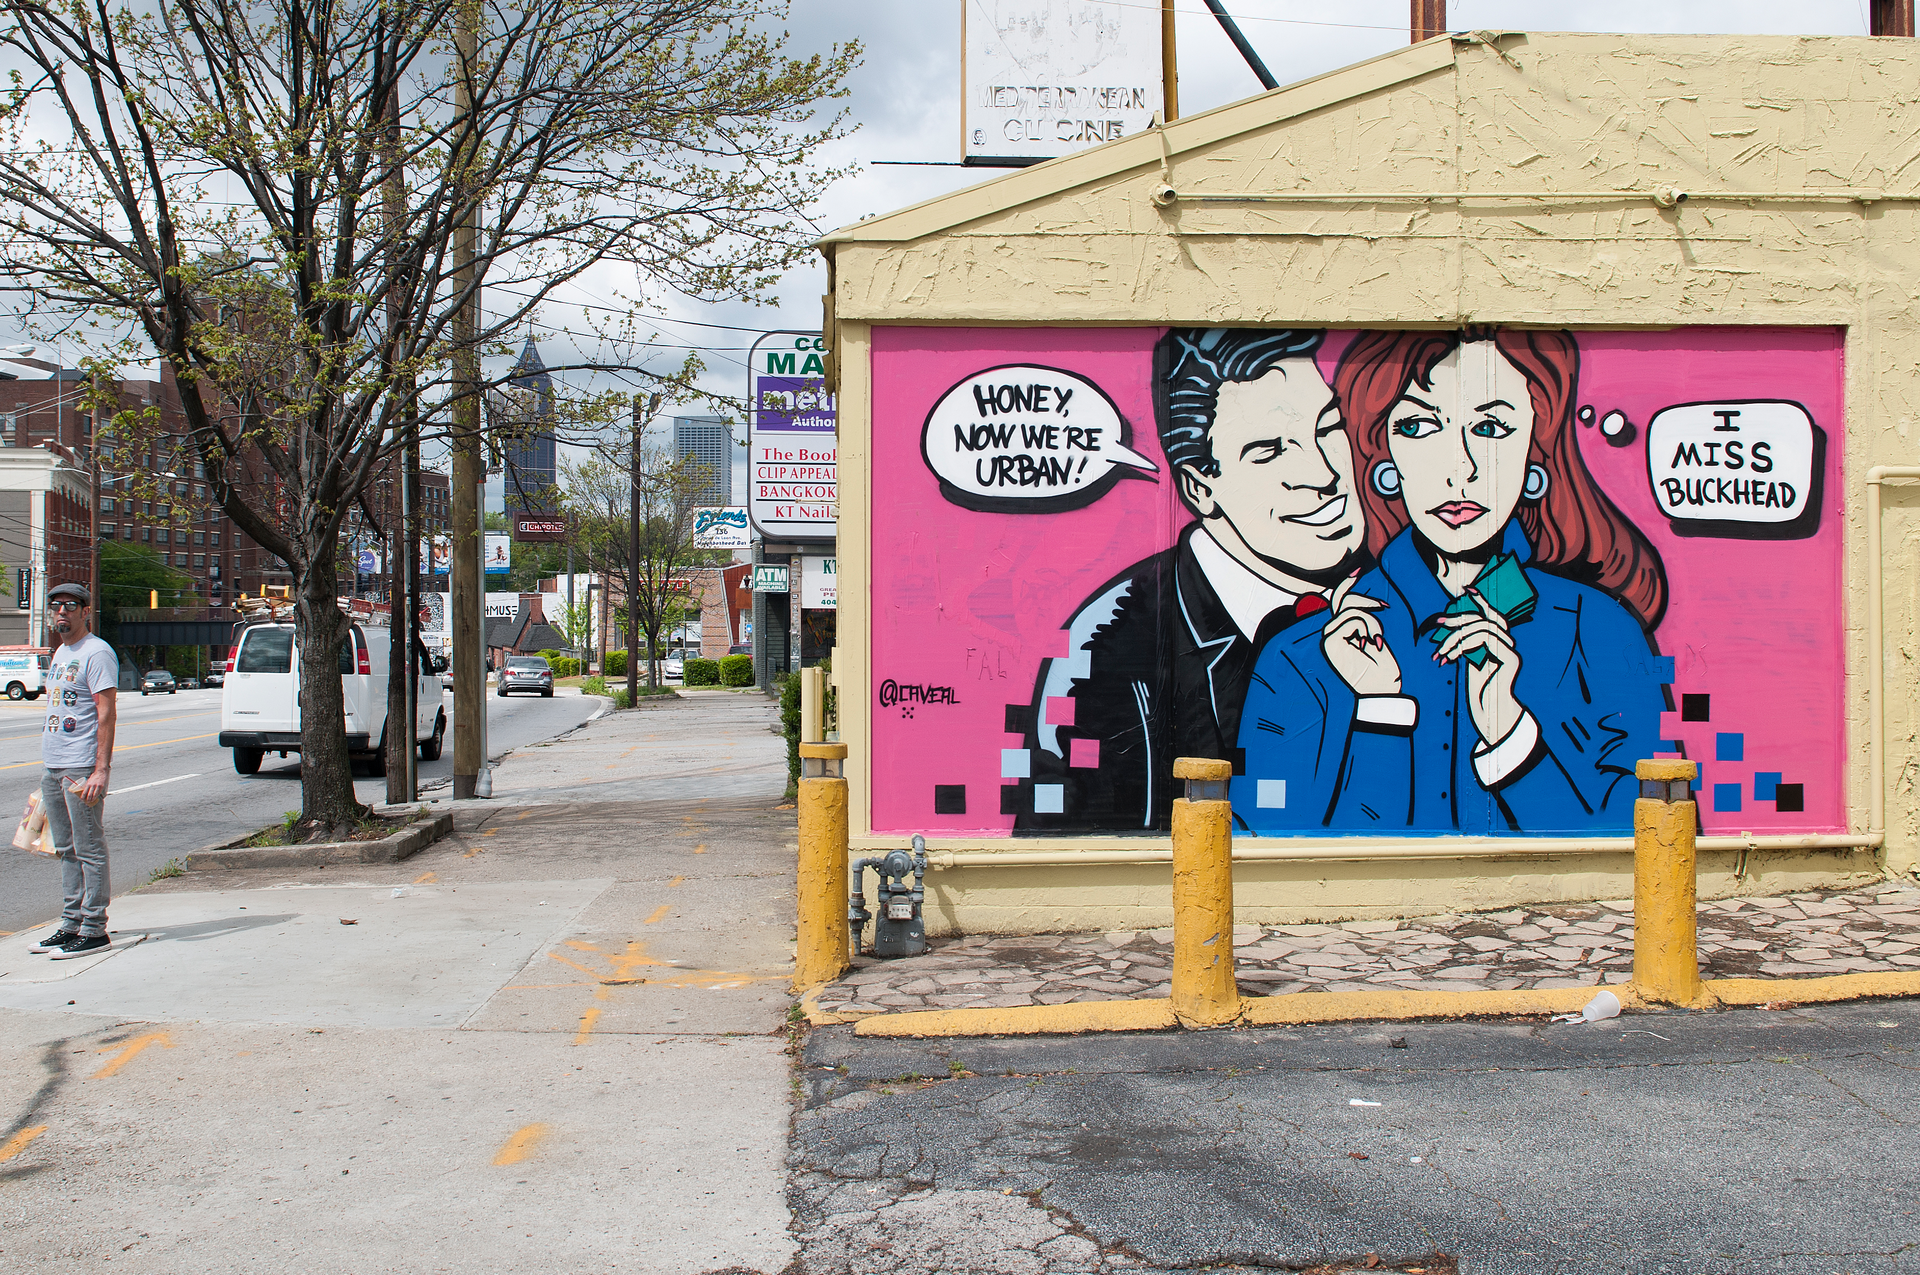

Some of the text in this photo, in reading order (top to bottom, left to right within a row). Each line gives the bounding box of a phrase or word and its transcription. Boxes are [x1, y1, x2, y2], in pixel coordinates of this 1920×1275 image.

[767, 352, 825, 374] MA
[973, 384, 1073, 418] HONEY,
[1713, 410, 1741, 431] I
[954, 423, 1103, 452] NOW WE'RE
[762, 448, 794, 460] The
[1671, 441, 1774, 473] MISS
[757, 466, 837, 480] CLIP APPEAL
[976, 454, 1089, 487] URBAN!
[760, 485, 836, 498] BANGKOK
[1660, 478, 1796, 508] BUCKHEAD
[775, 505, 836, 518] KT Nail
[756, 568, 787, 581] ATM
